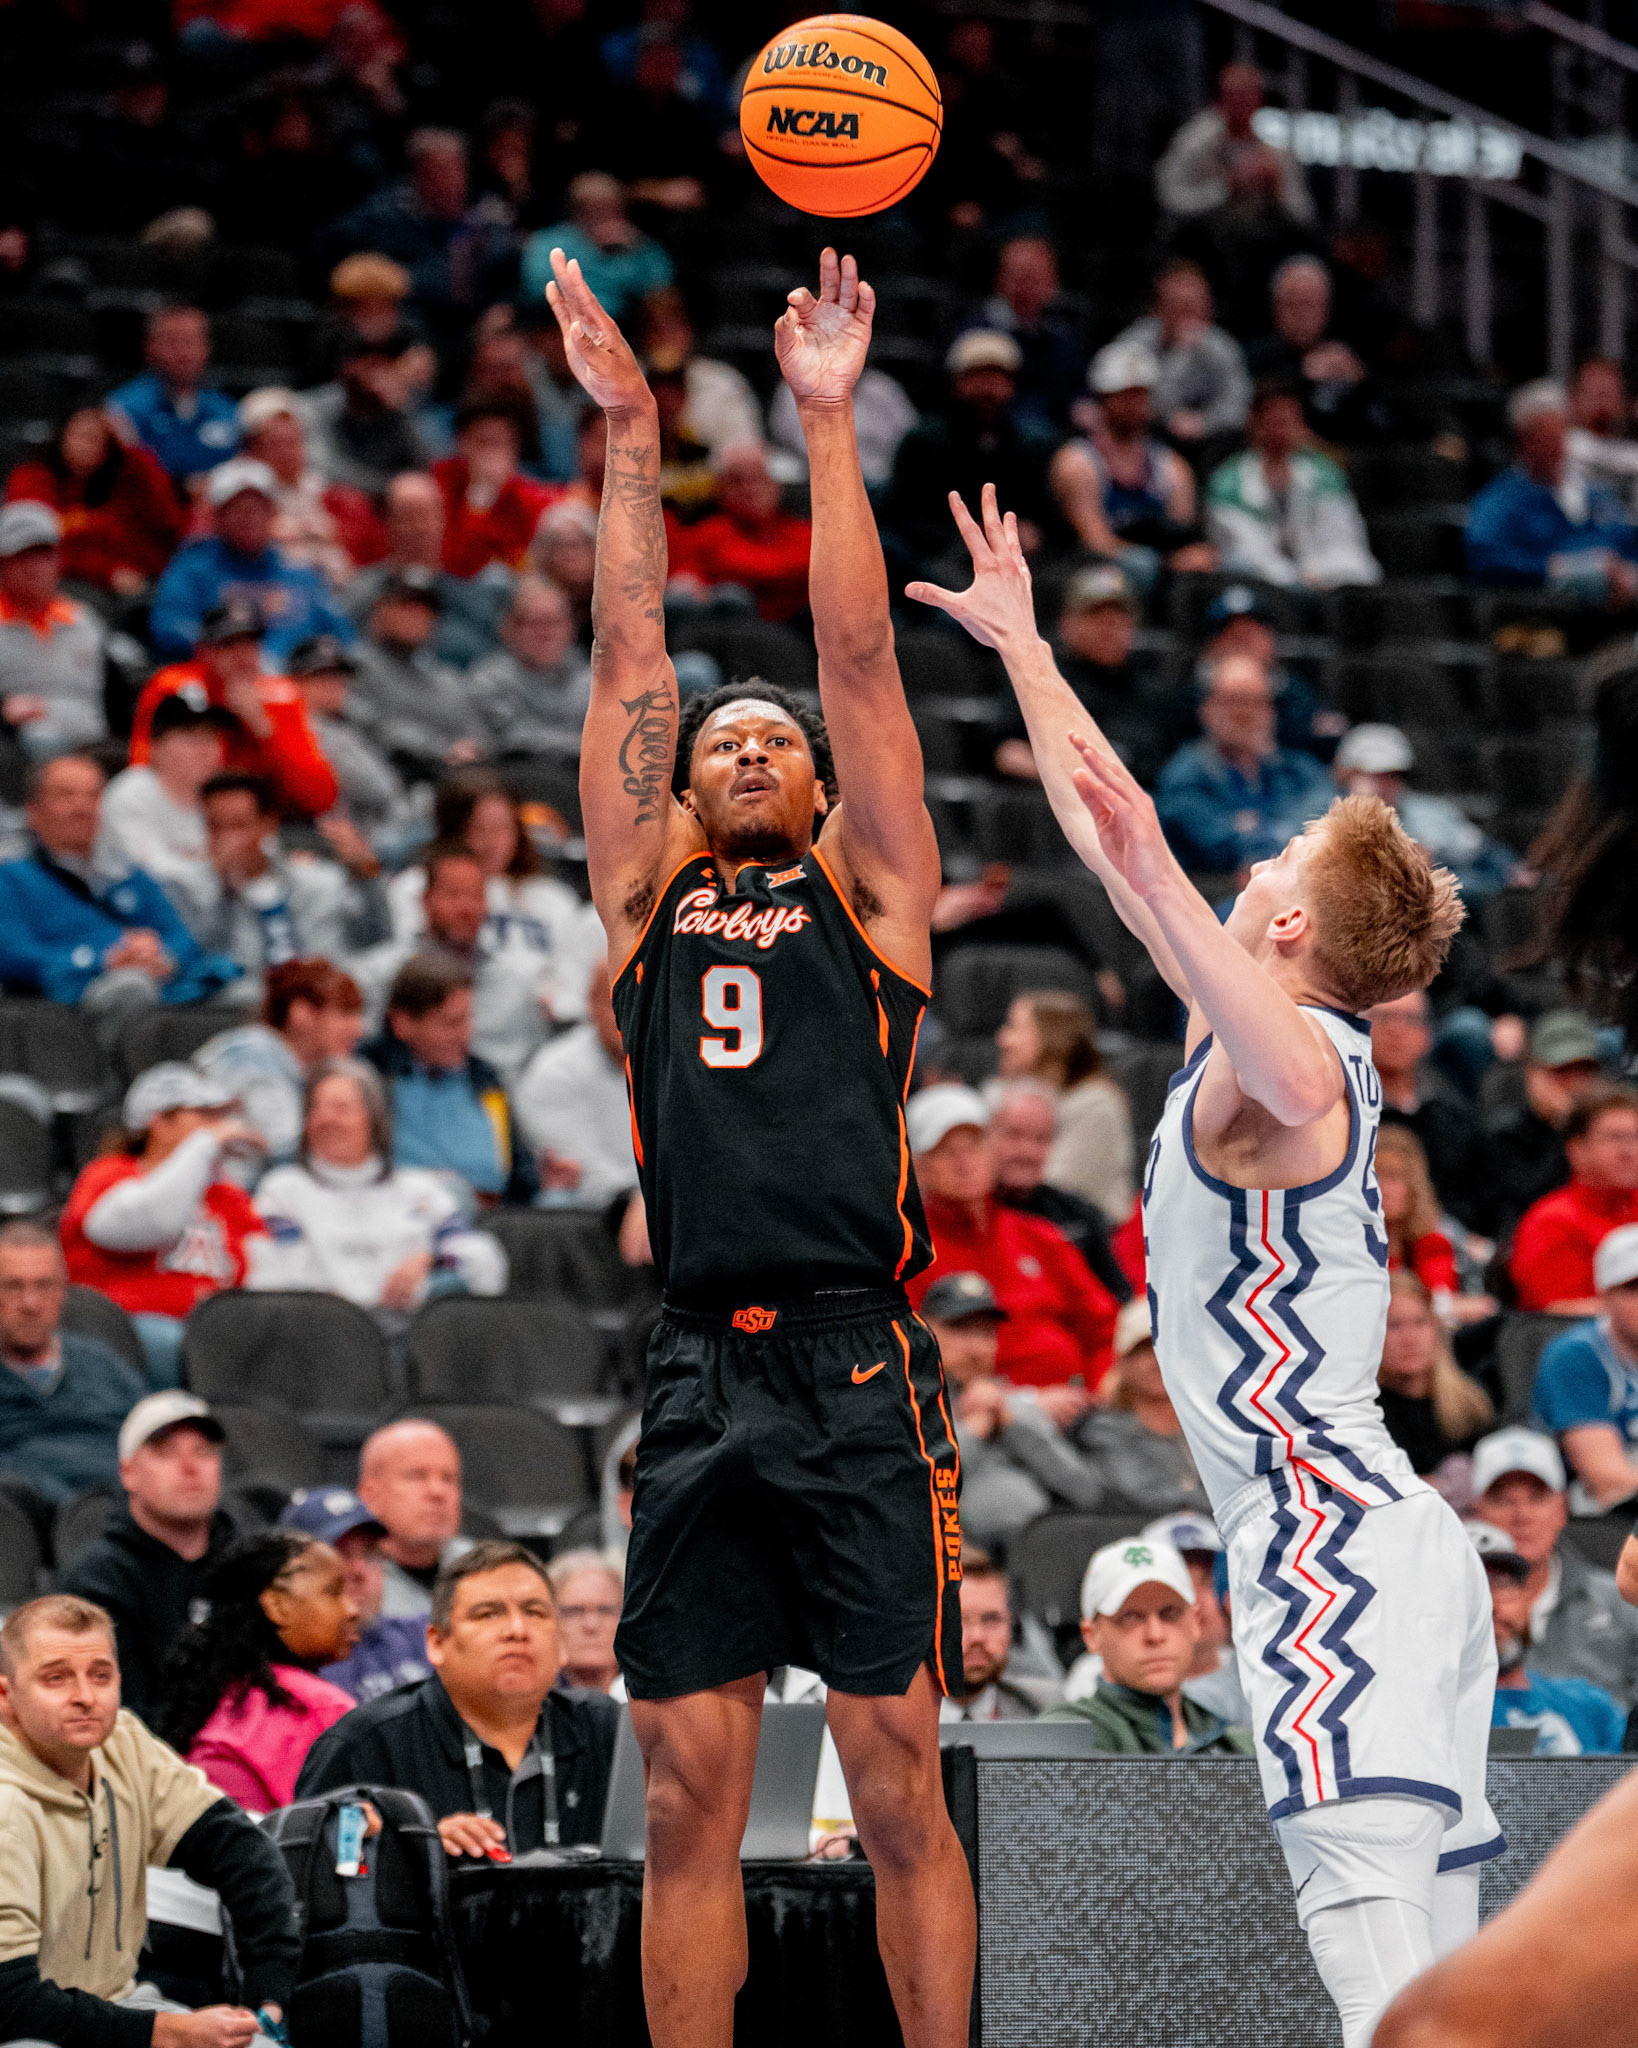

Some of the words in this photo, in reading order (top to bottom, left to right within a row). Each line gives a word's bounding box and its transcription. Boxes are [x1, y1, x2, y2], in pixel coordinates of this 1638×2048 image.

[763, 41, 888, 88] Wilson
[766, 104, 859, 140] NCAA
[673, 886, 812, 950] Cowboys
[699, 964, 764, 1069] 9
[731, 1306, 777, 1333] OSU
[935, 1467, 963, 1581] POKES
